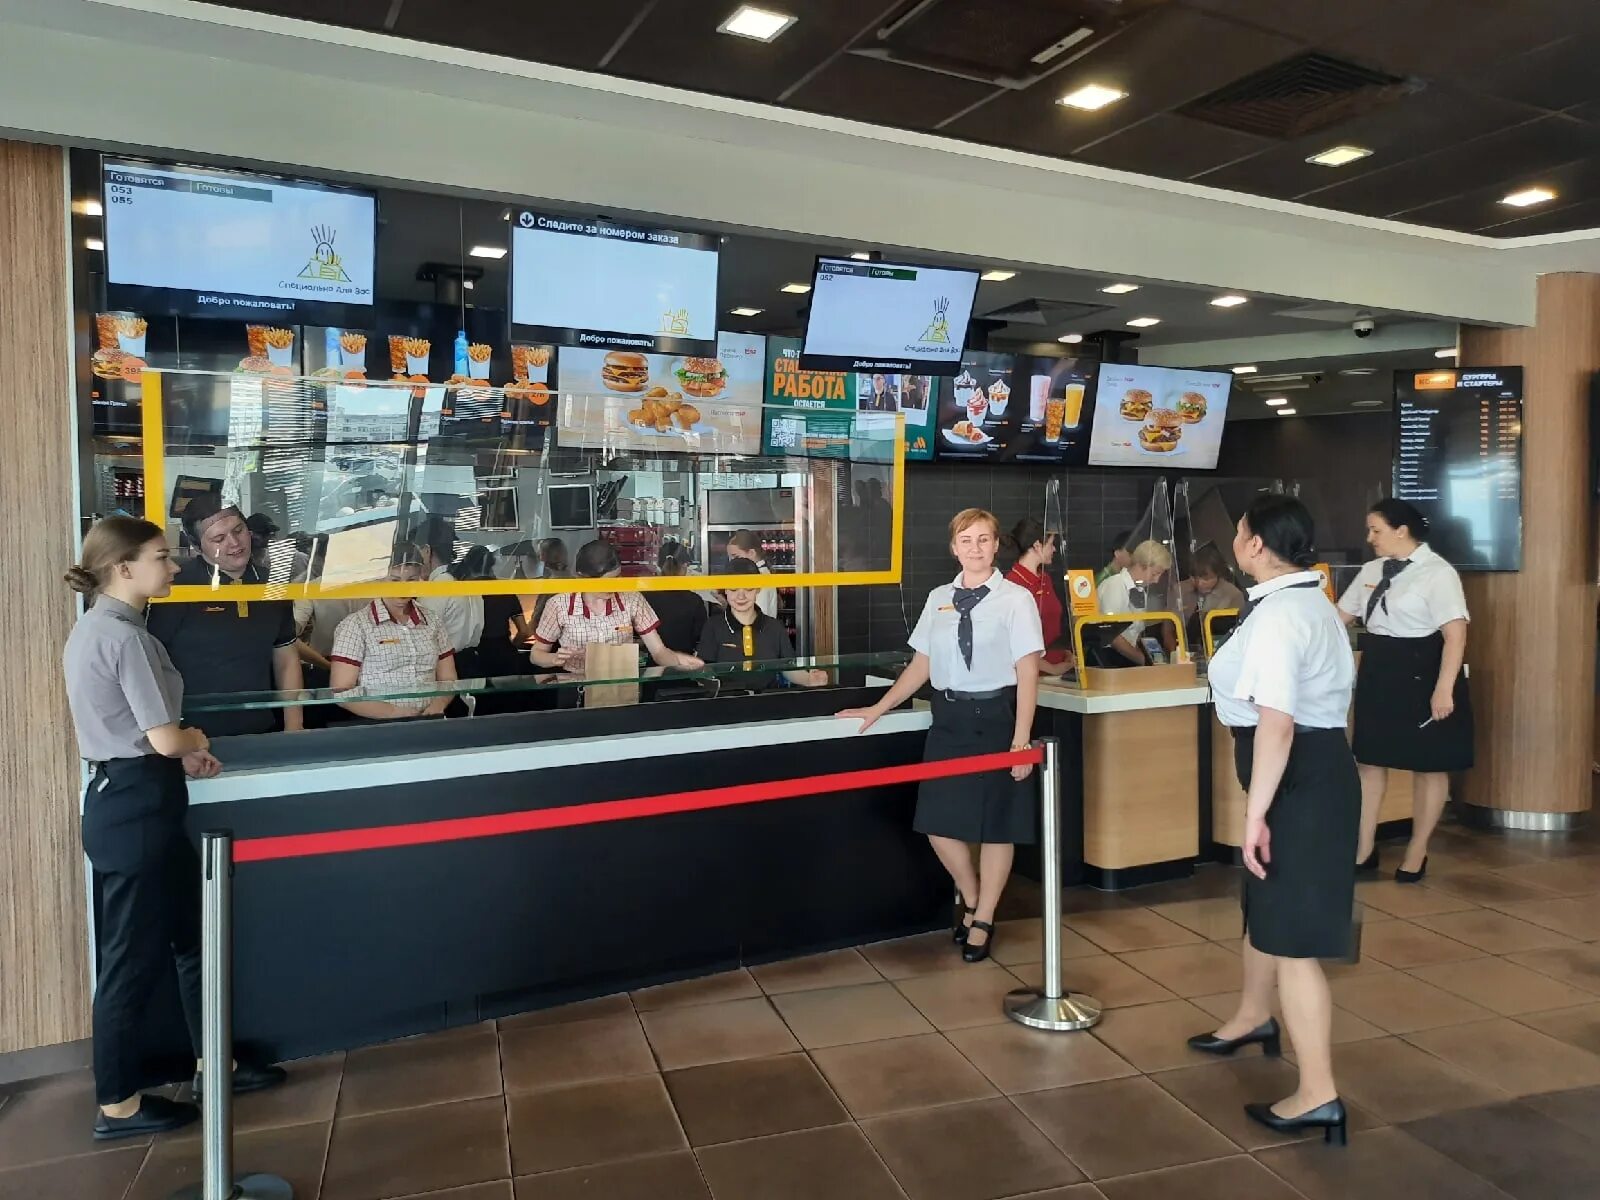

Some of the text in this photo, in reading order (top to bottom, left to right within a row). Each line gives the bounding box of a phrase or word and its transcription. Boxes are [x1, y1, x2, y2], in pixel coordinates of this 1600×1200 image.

[110, 172, 165, 186] Готовятся
[111, 185, 133, 195] 053
[196, 182, 234, 194] Готовы
[111, 196, 133, 205] 055
[538, 217, 679, 245] Следите за номером заказа
[197, 295, 296, 310] Добро пожаловать!
[580, 333, 655, 347] Добро пожаловать!
[773, 372, 847, 400] РАБОТА
[793, 399, 826, 409] ОСТАЕТСЯ
